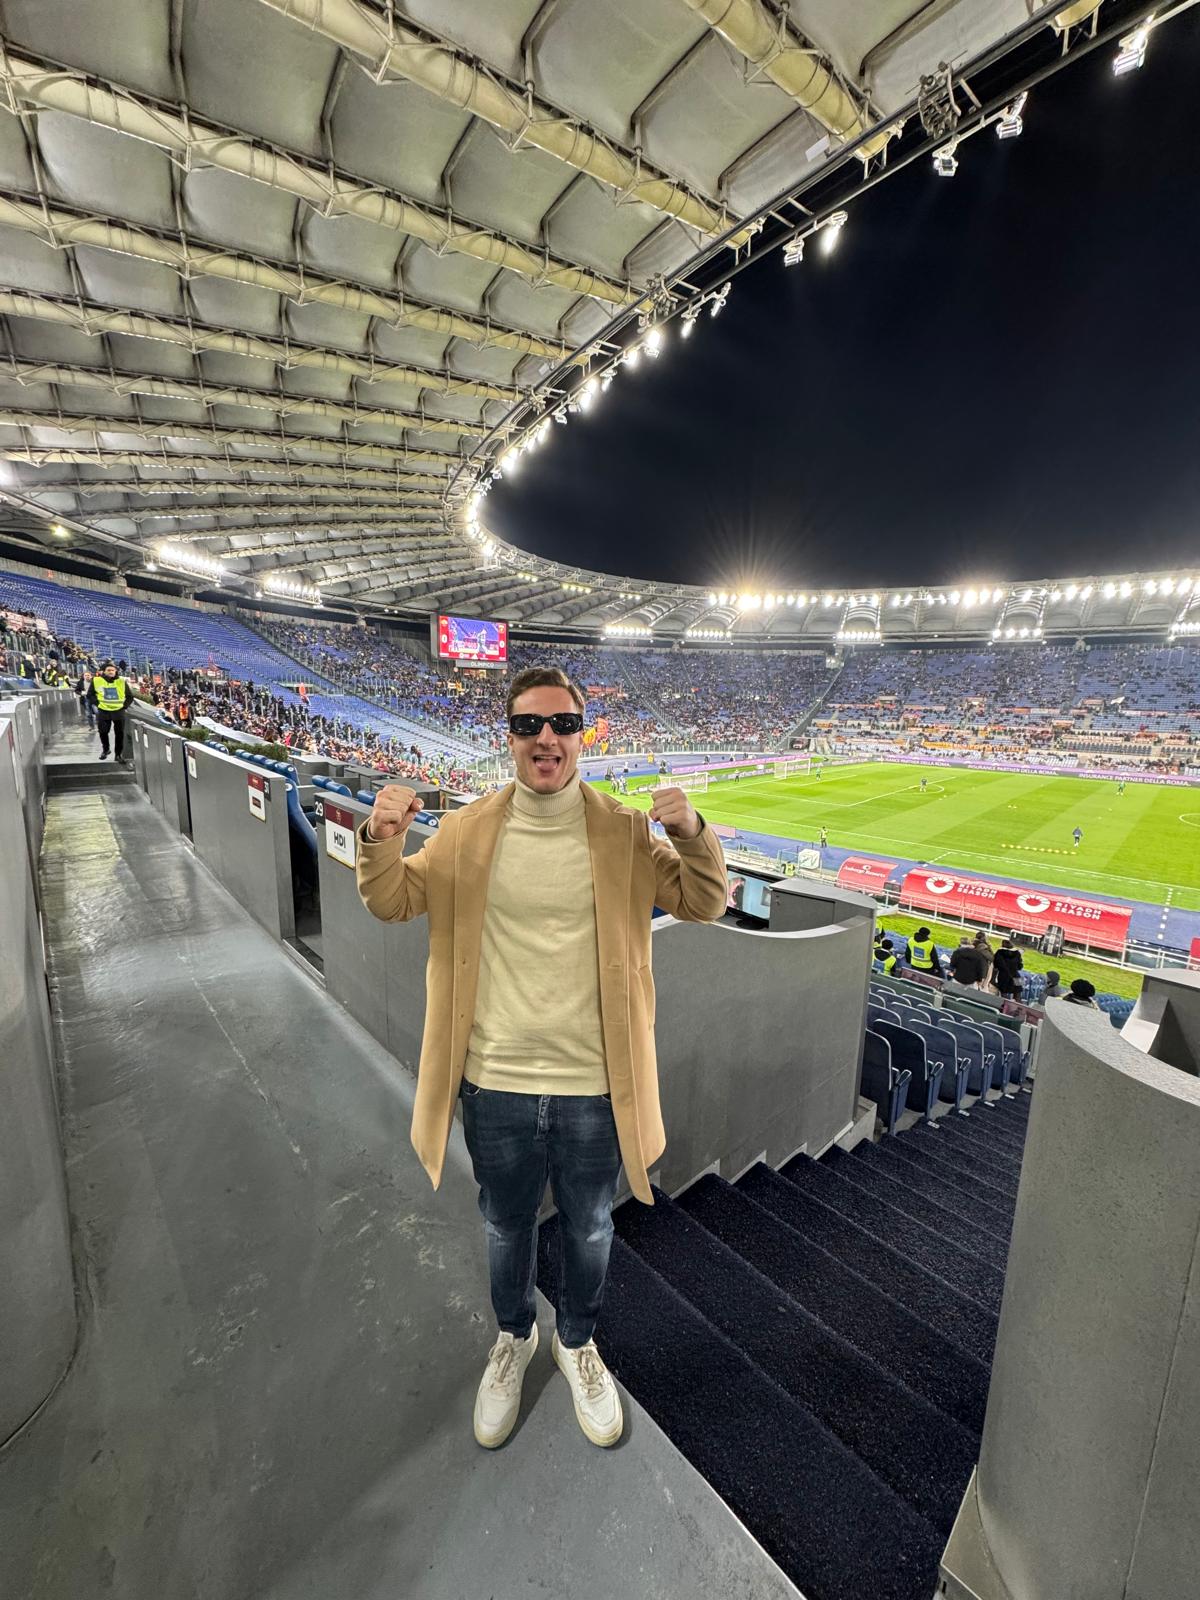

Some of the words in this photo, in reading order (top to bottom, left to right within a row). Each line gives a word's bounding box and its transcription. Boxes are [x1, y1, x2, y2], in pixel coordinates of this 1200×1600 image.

[441, 634, 448, 643] 0
[1114, 775, 1143, 783] PARTNER
[315, 801, 324, 816] 29
[334, 832, 346, 848] HDI
[957, 887, 996, 899] SEASON
[959, 883, 997, 894] RIYADH
[1054, 906, 1100, 920] SEASON
[1055, 901, 1102, 915] RIYADH
